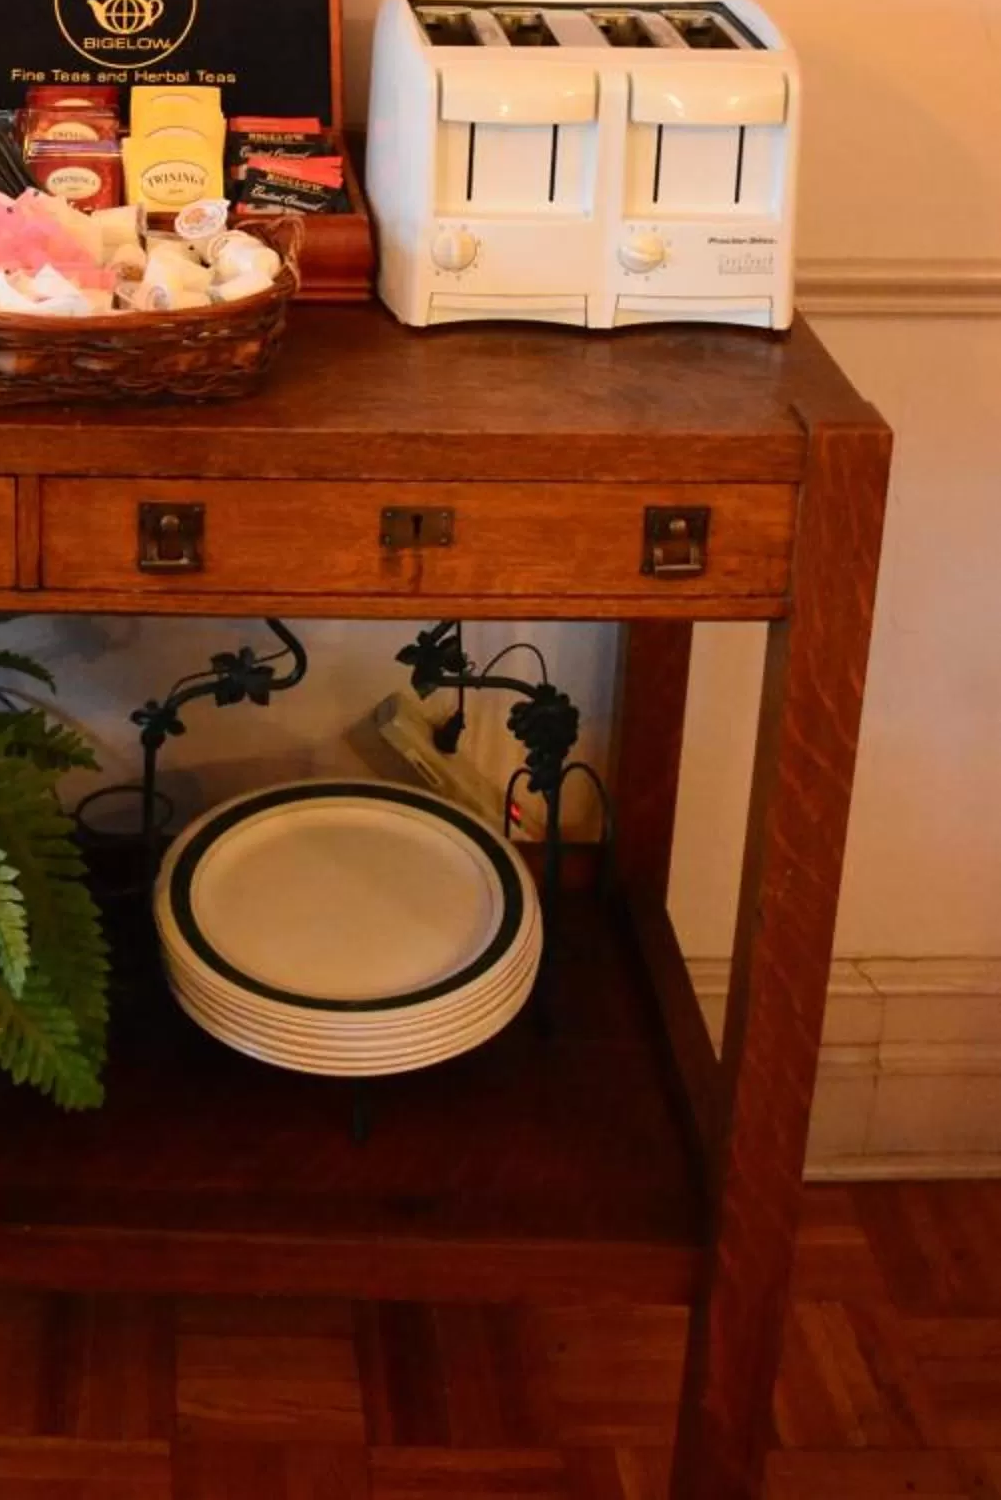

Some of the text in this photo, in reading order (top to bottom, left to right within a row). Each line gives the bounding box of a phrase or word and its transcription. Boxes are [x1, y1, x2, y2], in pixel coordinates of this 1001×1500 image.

[83, 37, 170, 50] BIGELOW
[10, 69, 237, 84] Fine Teas and Herbal Teas
